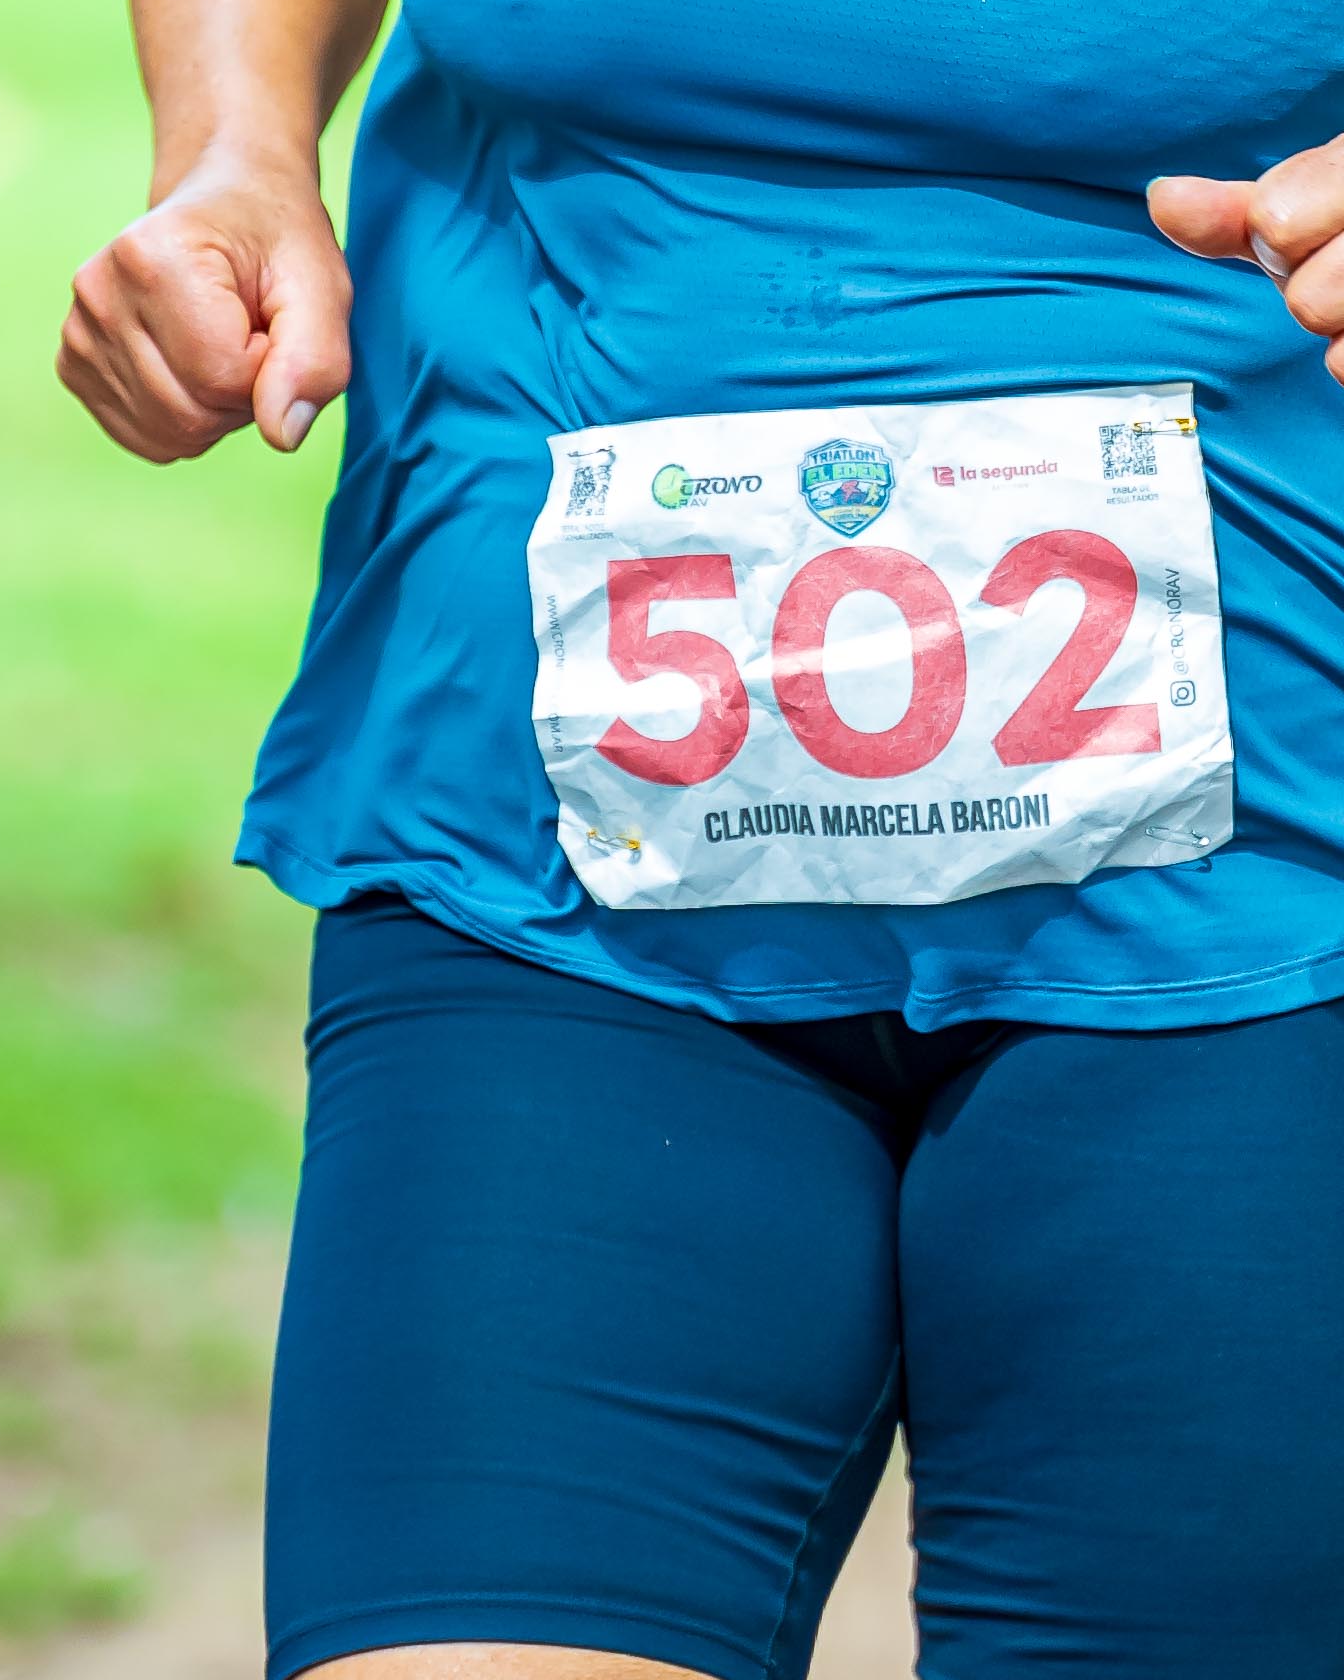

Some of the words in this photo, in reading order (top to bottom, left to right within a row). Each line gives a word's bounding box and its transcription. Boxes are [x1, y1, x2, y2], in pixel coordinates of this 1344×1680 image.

[809, 449, 876, 464] TRIATLON
[960, 466, 977, 480] la
[980, 459, 1058, 480] segunda
[593, 528, 1162, 787] 502
[705, 803, 815, 843] CLAUDIA
[819, 802, 946, 837] MARCELA
[950, 793, 1050, 834] BARONI
